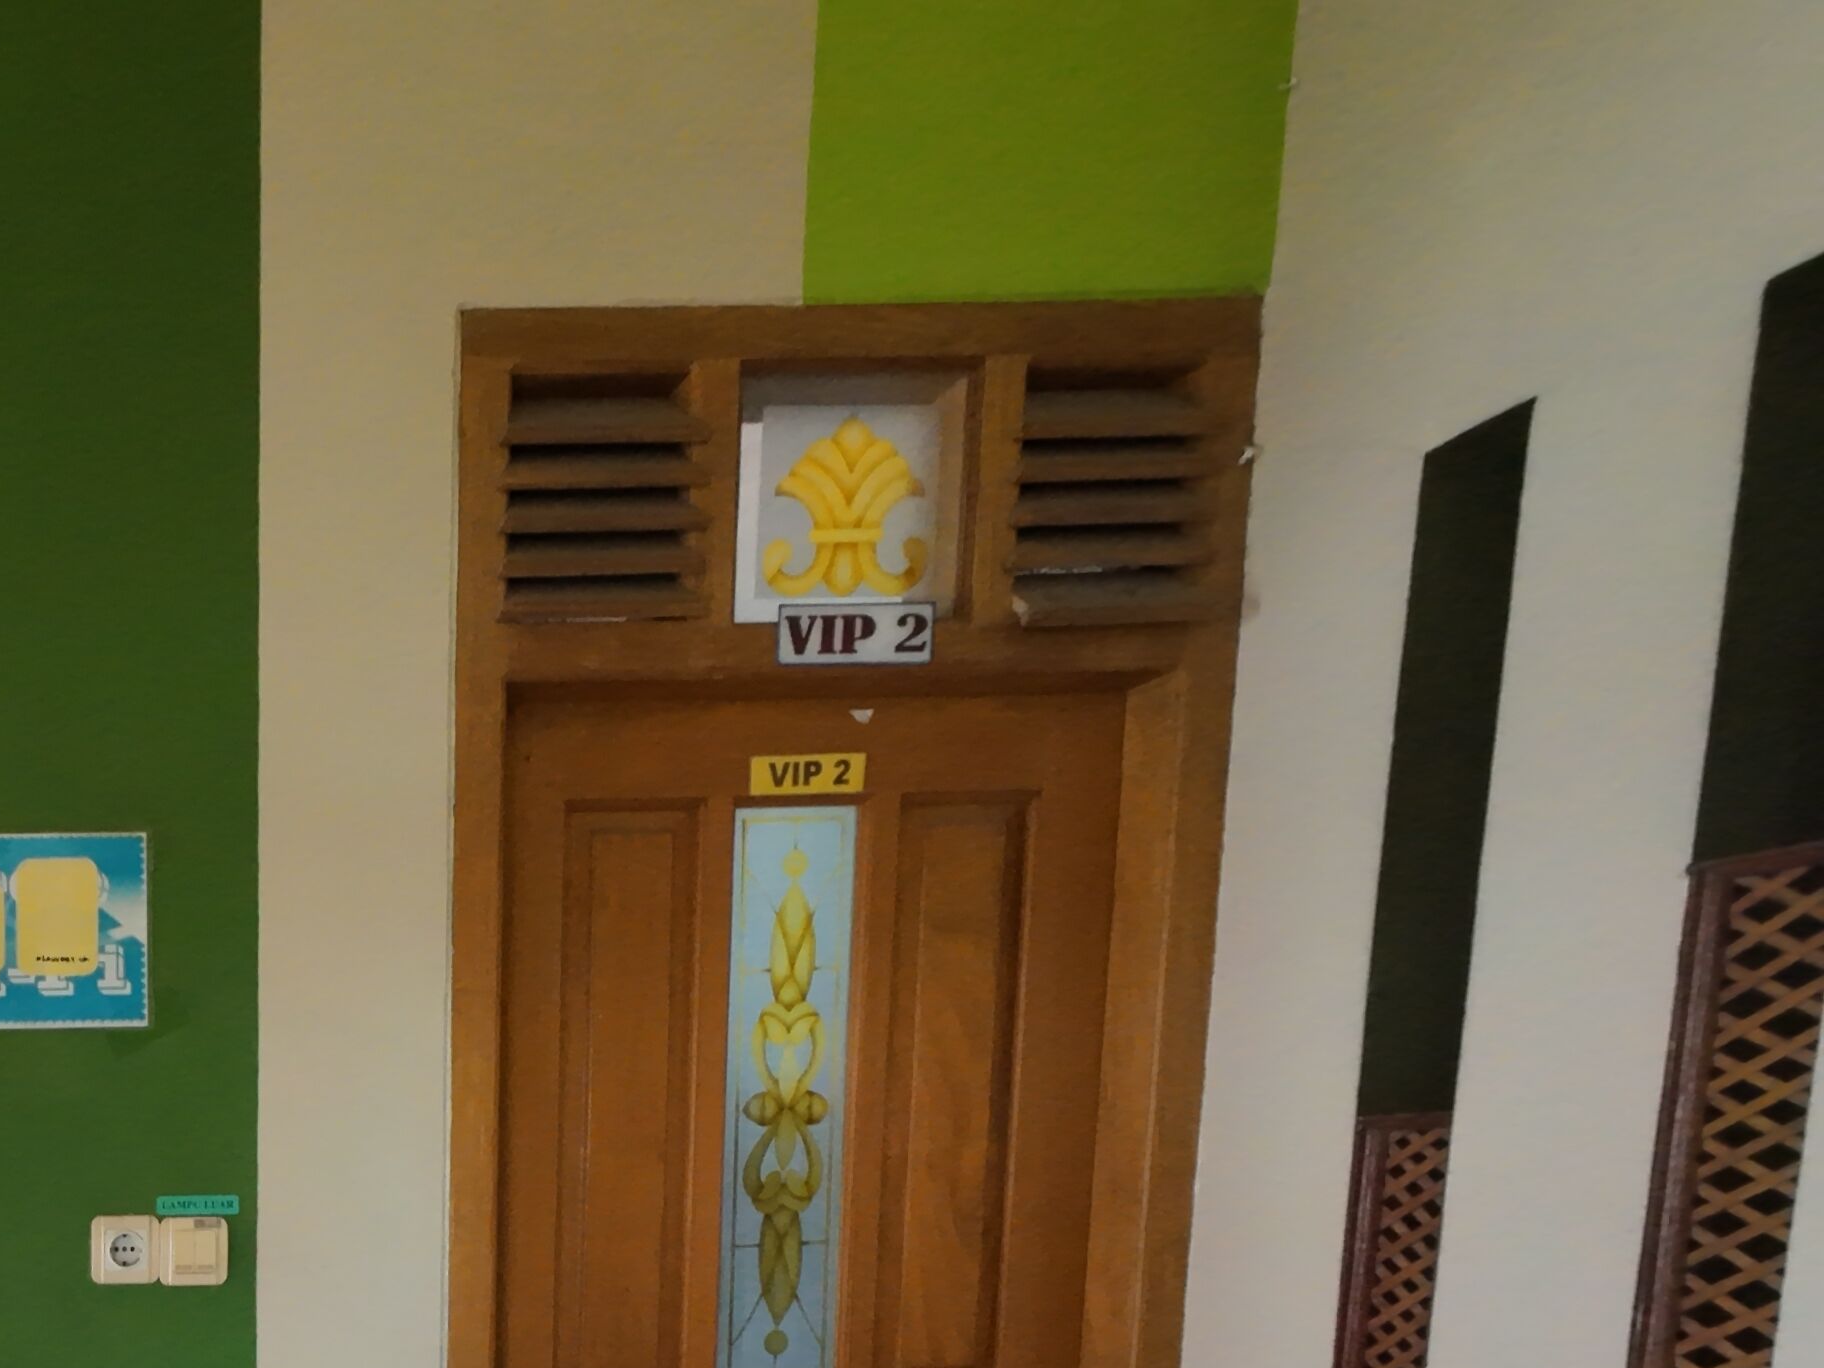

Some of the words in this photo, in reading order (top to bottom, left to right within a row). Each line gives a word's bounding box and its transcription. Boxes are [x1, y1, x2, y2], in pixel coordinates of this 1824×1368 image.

[785, 614, 877, 655] VIP
[894, 612, 929, 653] 2
[768, 760, 824, 788] VIP
[832, 759, 852, 786] 2
